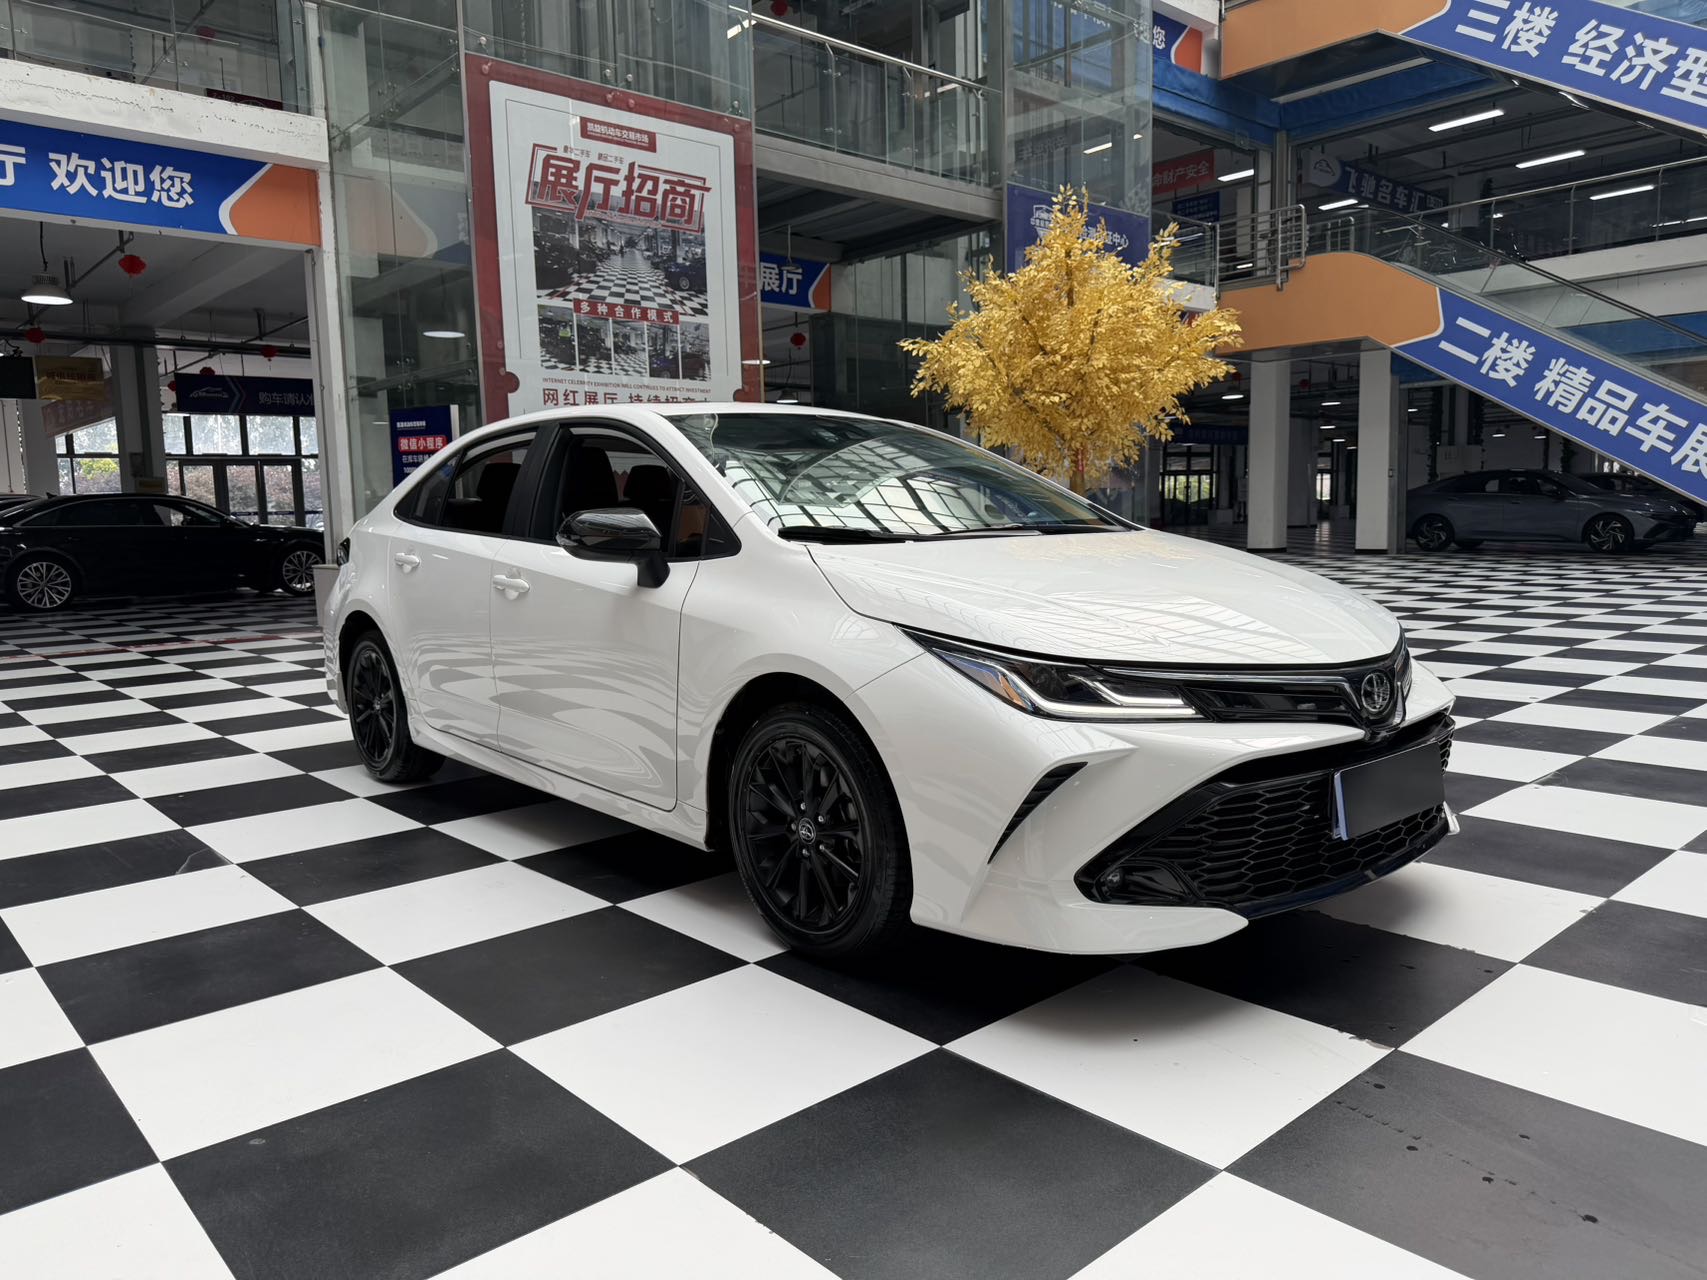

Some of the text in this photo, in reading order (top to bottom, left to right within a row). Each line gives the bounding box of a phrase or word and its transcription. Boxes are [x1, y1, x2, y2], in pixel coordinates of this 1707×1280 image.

[1455, 0, 1707, 107] 三楼 经济型
[48, 152, 194, 209] 欢迎您
[537, 154, 712, 226] 展厅招商
[760, 262, 803, 295] 展厅
[580, 301, 674, 323] 多种合作模式
[543, 388, 618, 406] 网红展厅
[1438, 316, 1707, 479] 二楼 精品车展
[400, 437, 443, 450] 微信小程序
